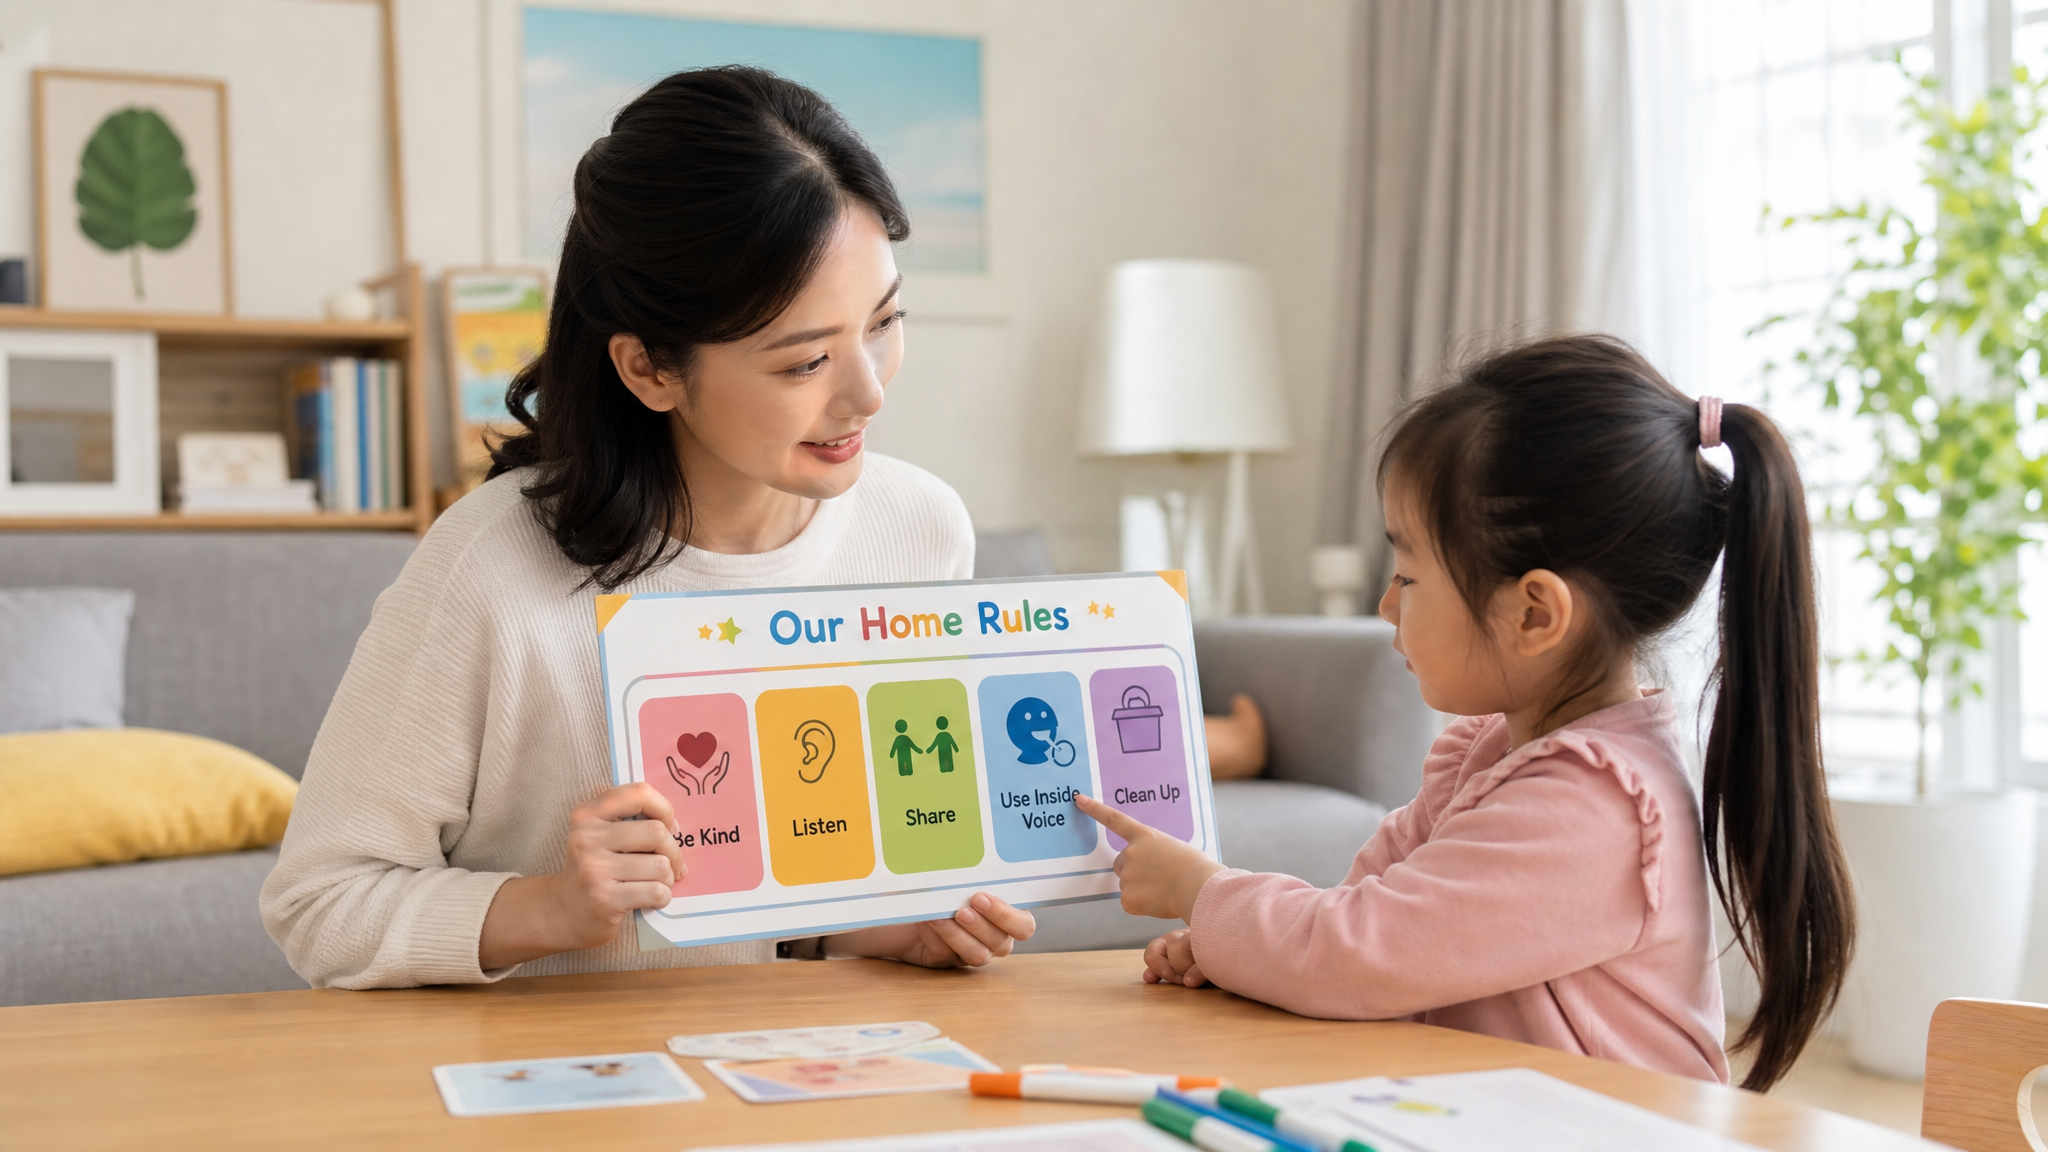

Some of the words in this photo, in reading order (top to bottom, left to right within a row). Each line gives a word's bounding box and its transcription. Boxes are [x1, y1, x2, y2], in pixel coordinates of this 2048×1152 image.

[769, 608, 845, 646] Our
[860, 605, 963, 641] Home
[977, 600, 1070, 635] Rules
[1000, 791, 1031, 809] Use
[1034, 784, 1081, 806] Inside
[1114, 787, 1157, 806] Clean
[1159, 783, 1181, 804] Up
[792, 817, 848, 837] Listen
[905, 807, 956, 828] Share
[1021, 812, 1066, 830] Voice
[699, 825, 741, 846] Kind
